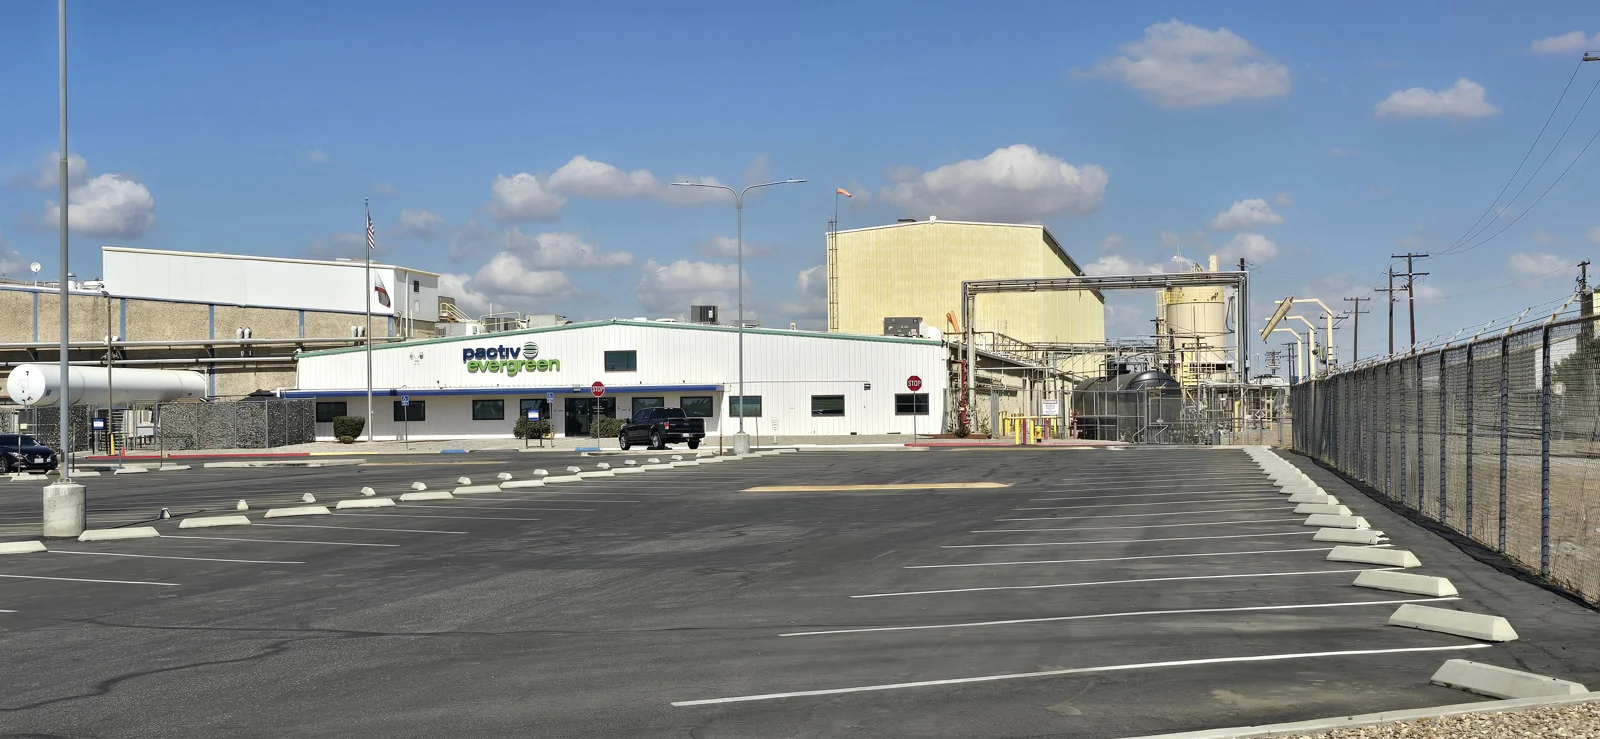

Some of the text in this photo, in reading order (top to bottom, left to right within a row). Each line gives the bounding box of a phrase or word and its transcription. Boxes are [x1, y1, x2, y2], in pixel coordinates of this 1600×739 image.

[462, 345, 521, 364] pactiv
[467, 359, 561, 377] evergreen
[592, 385, 605, 393] STOP
